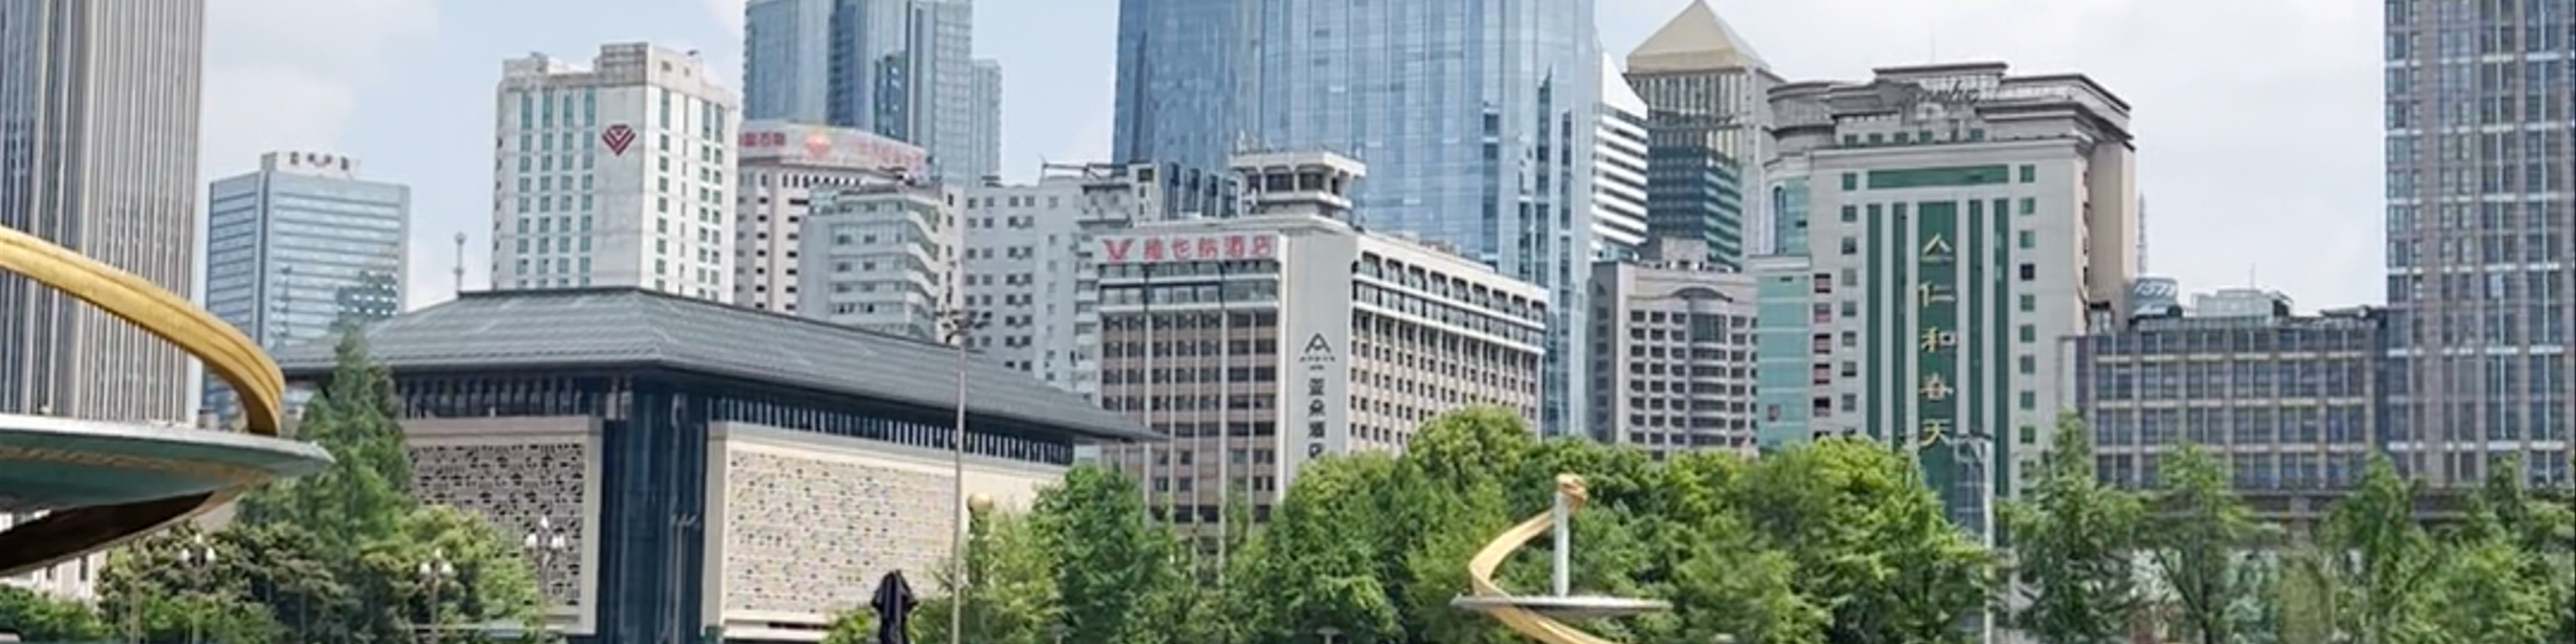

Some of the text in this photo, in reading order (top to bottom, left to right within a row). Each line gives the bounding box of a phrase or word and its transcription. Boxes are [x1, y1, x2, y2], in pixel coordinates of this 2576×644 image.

[1144, 235, 1271, 260] 维也纳酒店
